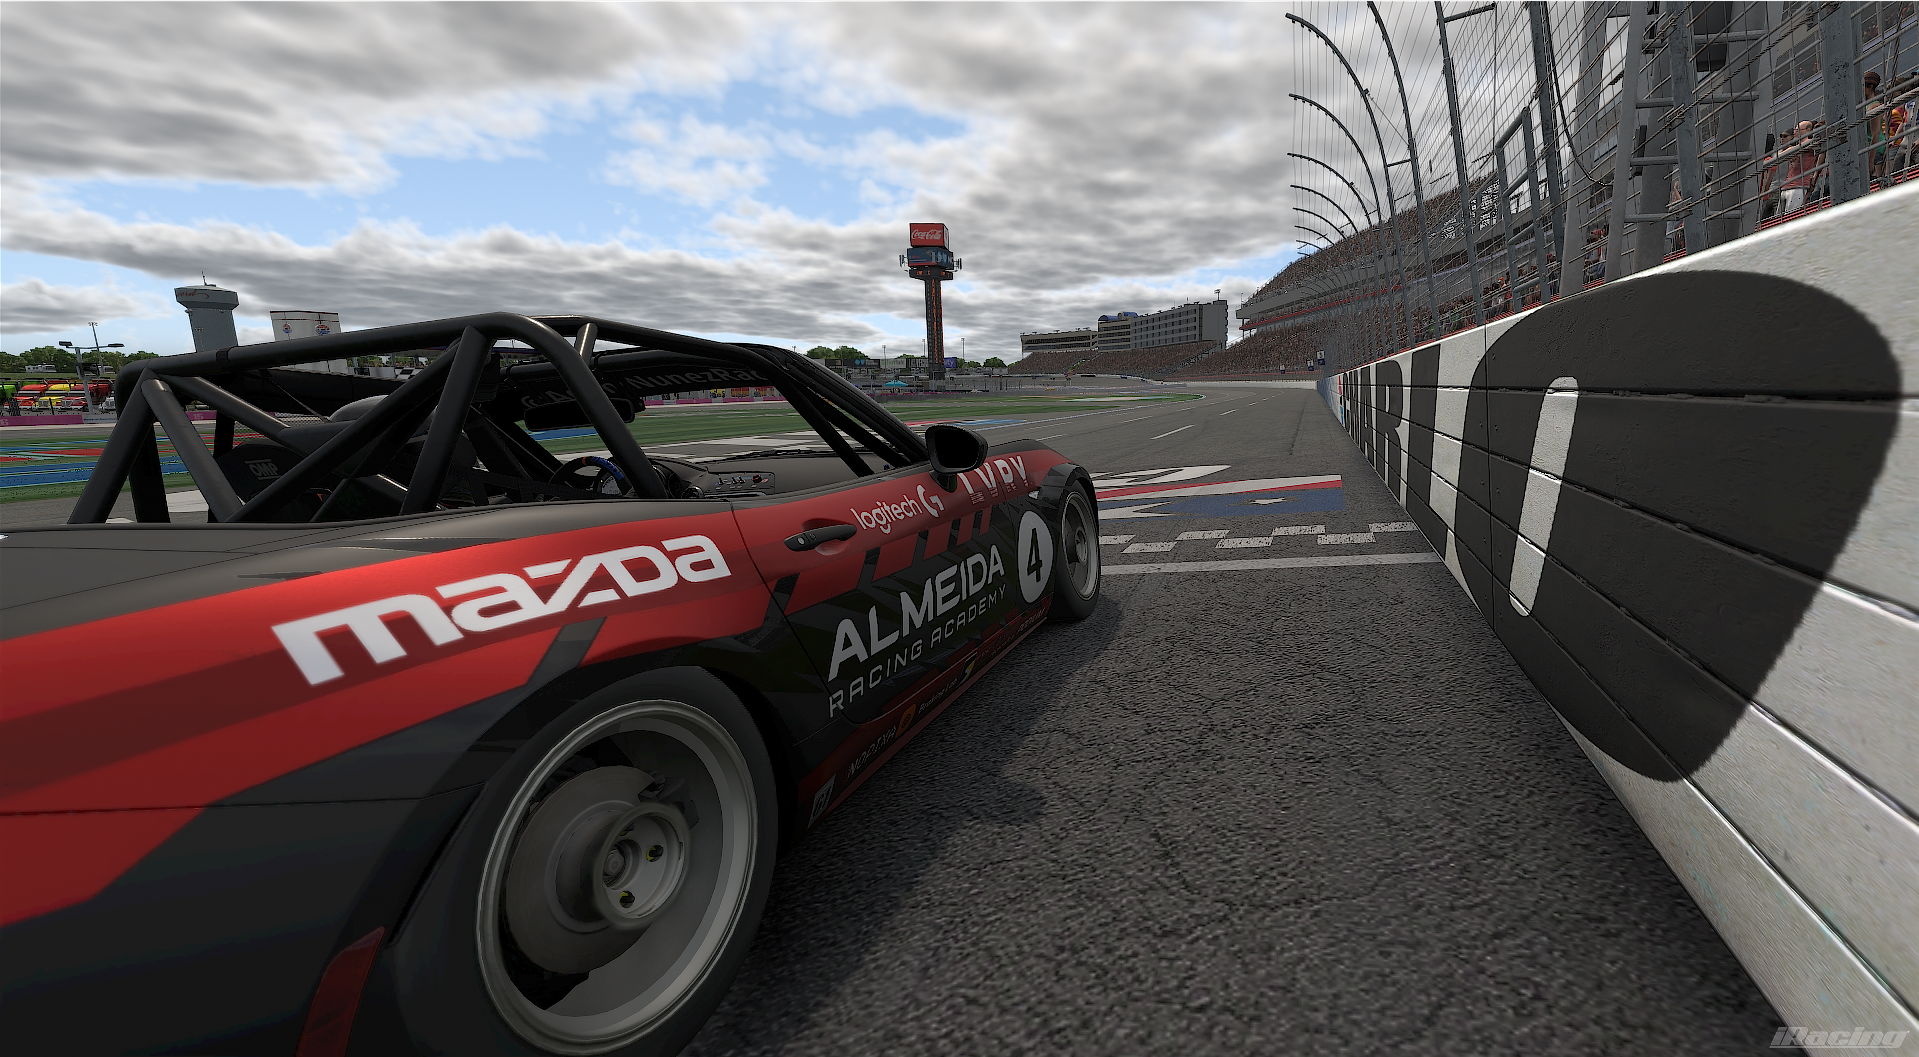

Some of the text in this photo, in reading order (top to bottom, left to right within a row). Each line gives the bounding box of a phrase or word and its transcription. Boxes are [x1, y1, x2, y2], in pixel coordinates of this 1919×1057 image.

[248, 462, 280, 477] OMP
[849, 493, 924, 535] logitech
[1027, 527, 1043, 583] 4
[827, 544, 1006, 684] ALMEIDA
[828, 638, 923, 718] RACING
[930, 584, 1007, 650] ACADEMY
